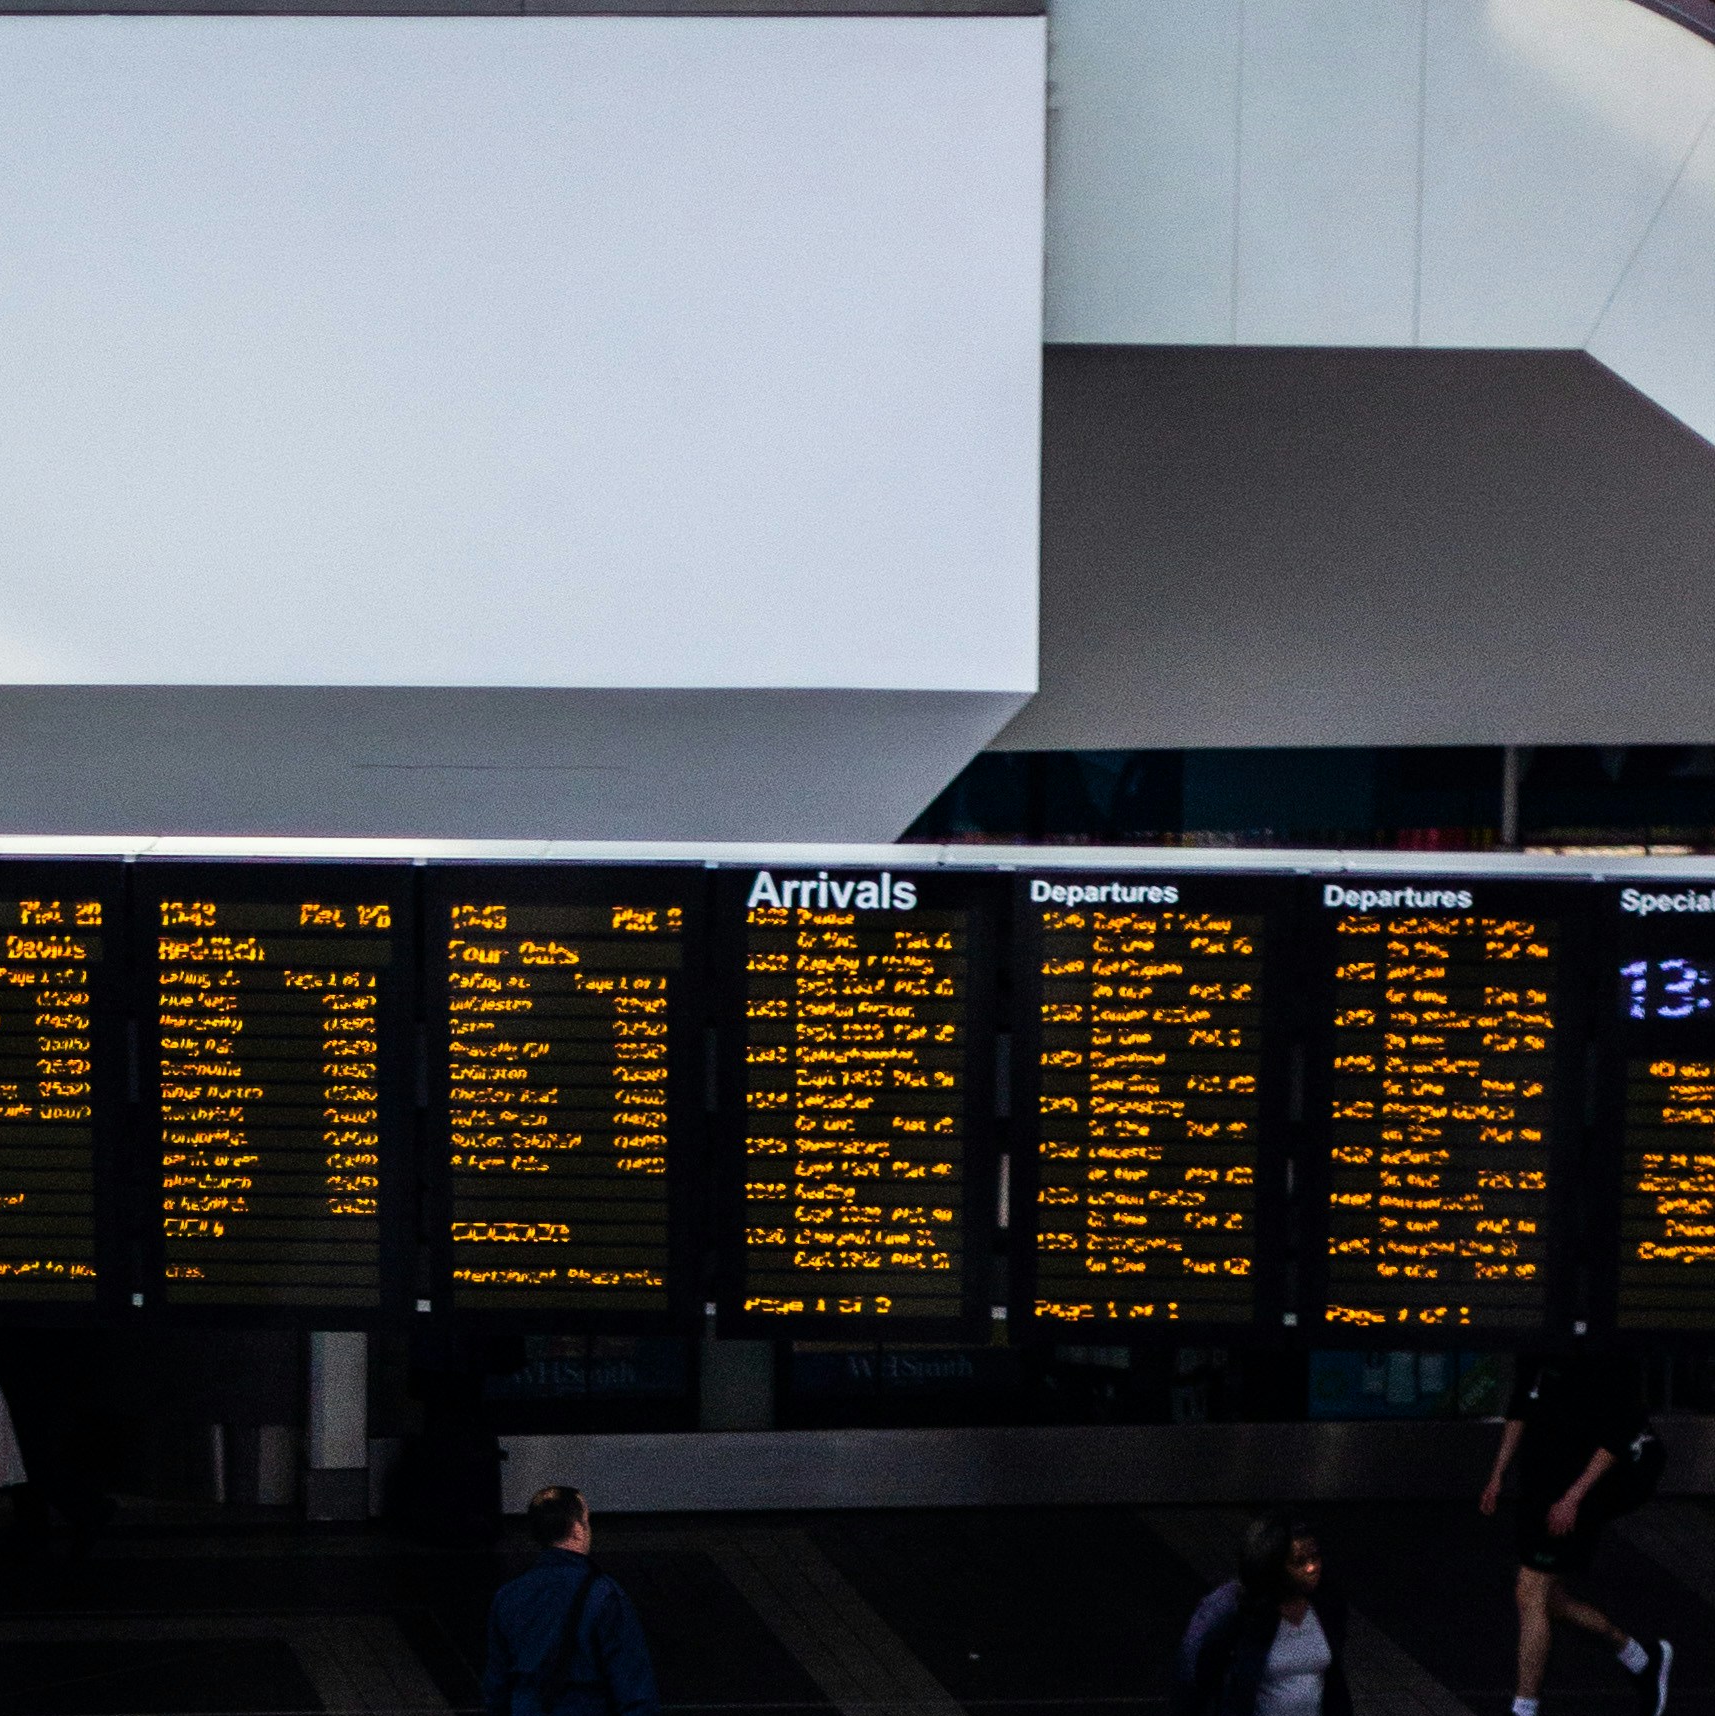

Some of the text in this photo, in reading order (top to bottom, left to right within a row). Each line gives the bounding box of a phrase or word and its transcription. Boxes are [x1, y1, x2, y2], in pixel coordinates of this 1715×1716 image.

[747, 871, 918, 910] Arrivals
[1031, 879, 1179, 907] Departures
[1324, 884, 1473, 912] Departures
[1619, 958, 1712, 1018] 13:
